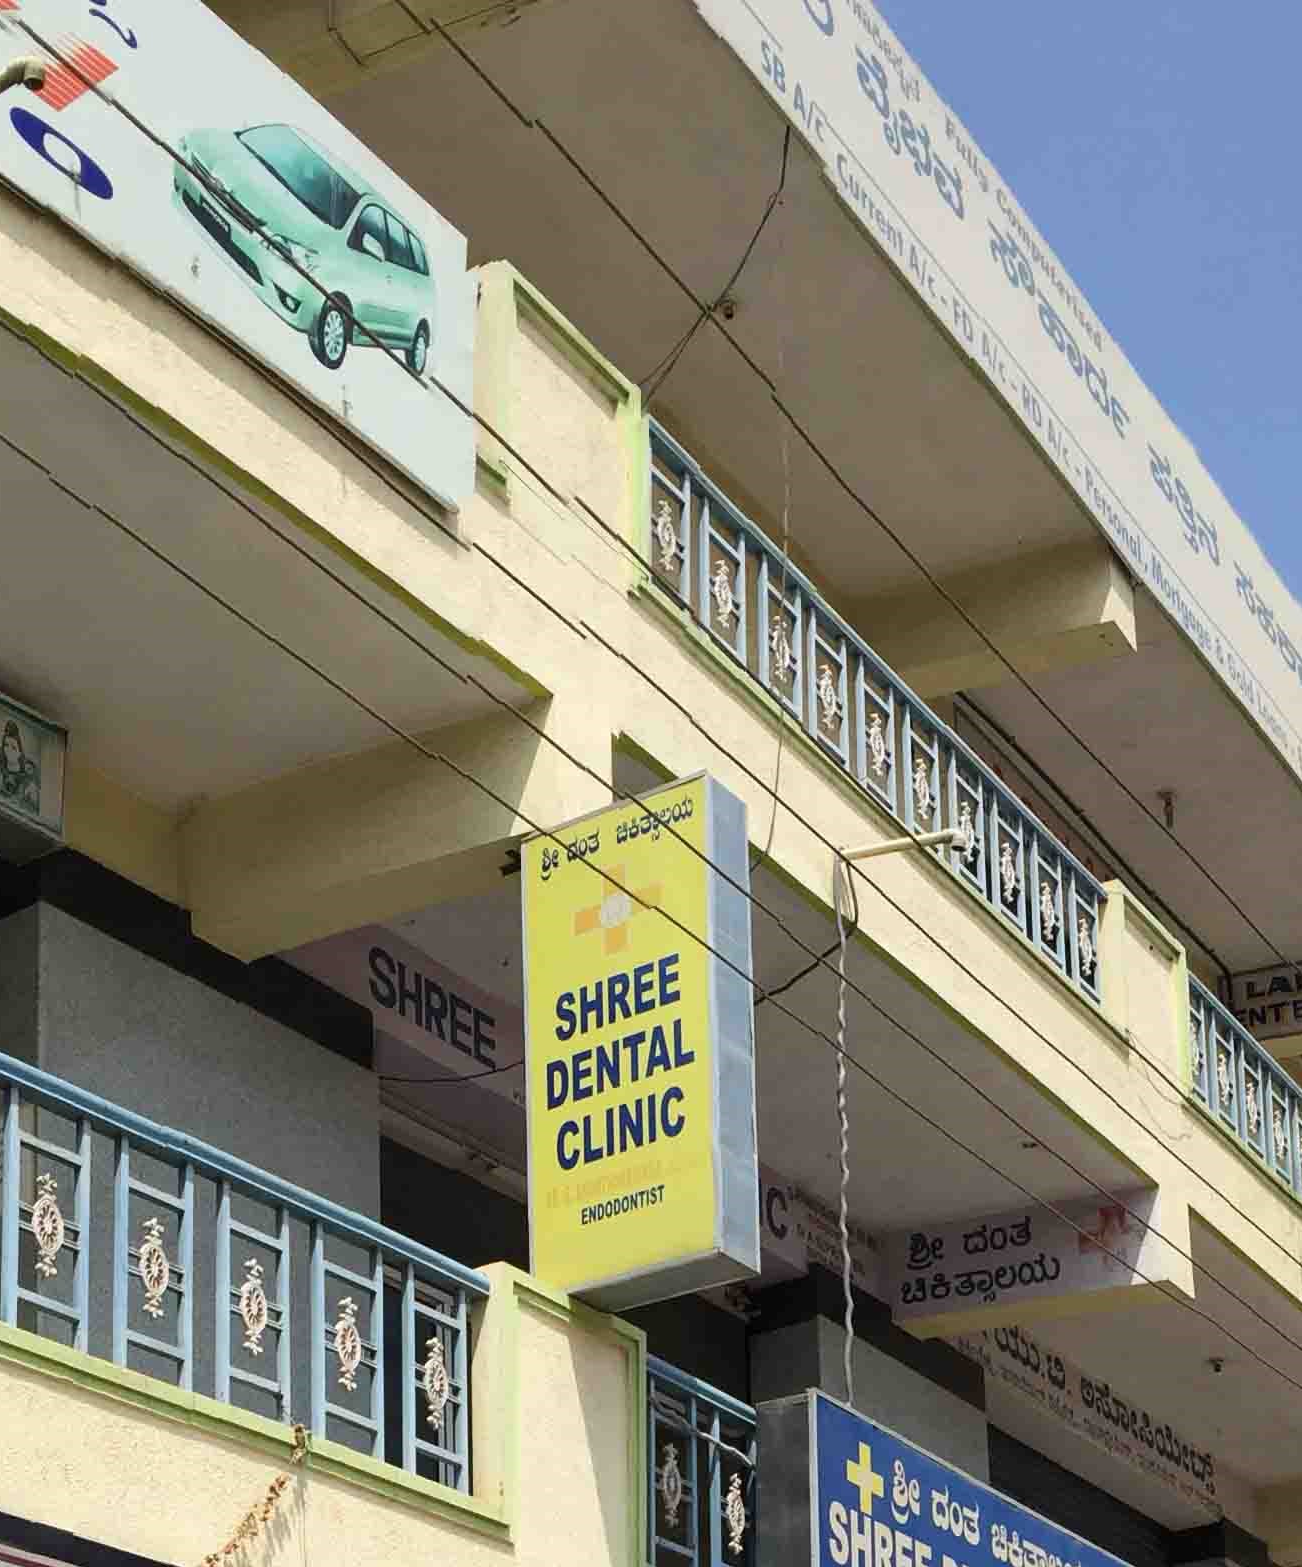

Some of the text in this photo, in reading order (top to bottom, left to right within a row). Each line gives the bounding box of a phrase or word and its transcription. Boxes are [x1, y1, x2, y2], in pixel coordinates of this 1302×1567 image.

[760, 41, 786, 93] SB
[837, 153, 905, 257] Current
[953, 297, 973, 343] FD
[1021, 383, 1042, 427] RD
[368, 945, 498, 1071] SHREE
[555, 952, 681, 1041] SHREE
[547, 1018, 695, 1111] DENTAL
[557, 1087, 685, 1171] CLINIC
[581, 1184, 666, 1225] ENDODONTIST
[906, 1232, 945, 1270] ಶ್ರೀ
[963, 1216, 1033, 1255] ದಂತ
[890, 1460, 921, 1524] ಶ್ರೀ
[931, 1485, 981, 1546] ದಂತ
